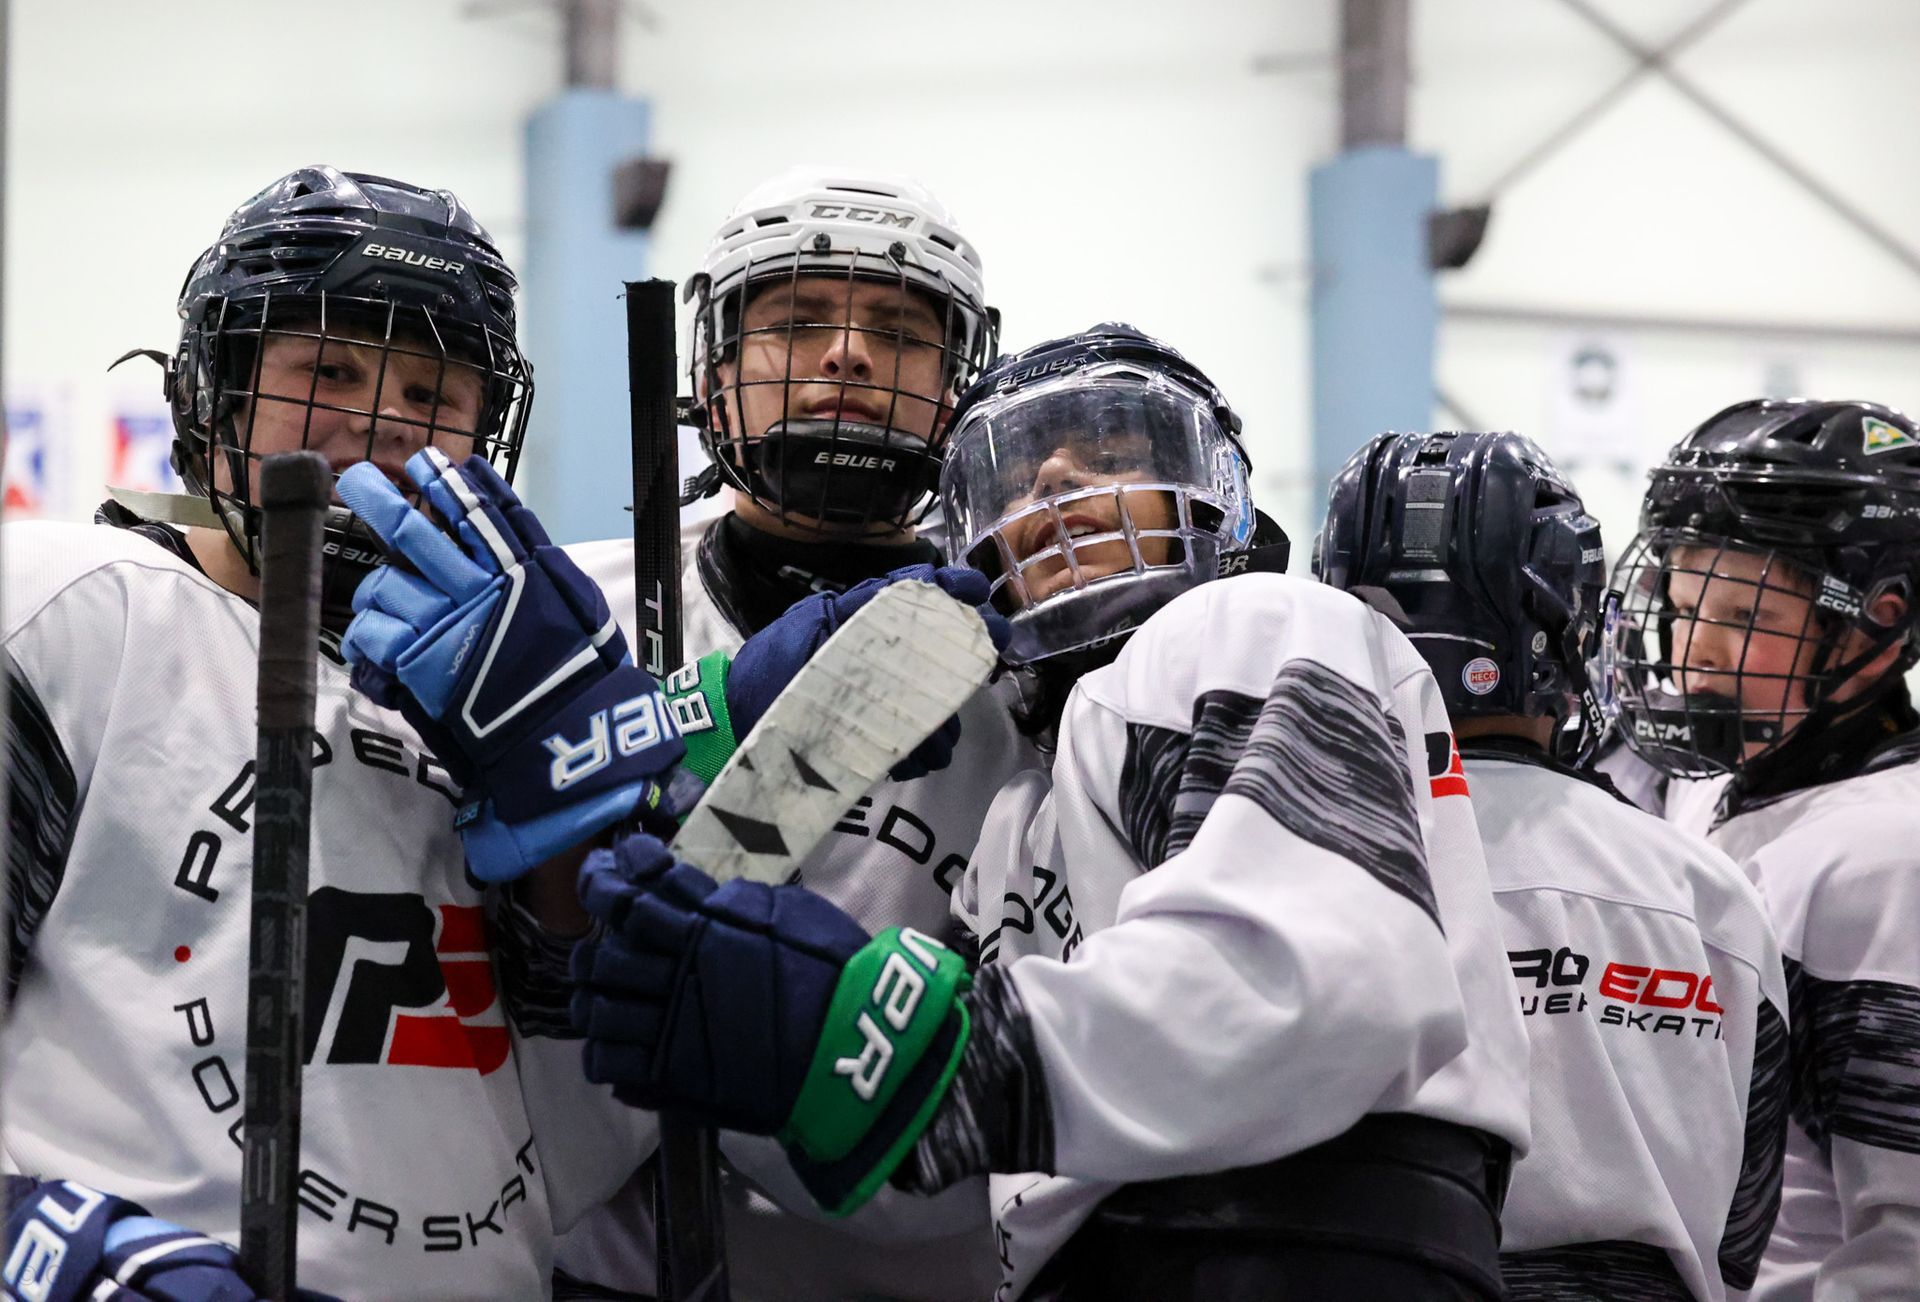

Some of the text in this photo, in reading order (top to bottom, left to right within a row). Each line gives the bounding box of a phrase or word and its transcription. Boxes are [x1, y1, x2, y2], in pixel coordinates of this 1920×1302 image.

[810, 205, 916, 229] CCM
[361, 243, 465, 276] BAUER
[1818, 594, 1861, 617] CCM
[1635, 719, 1692, 741] CCM
[1507, 946, 1590, 989] RO
[422, 1133, 535, 1253] SKAT
